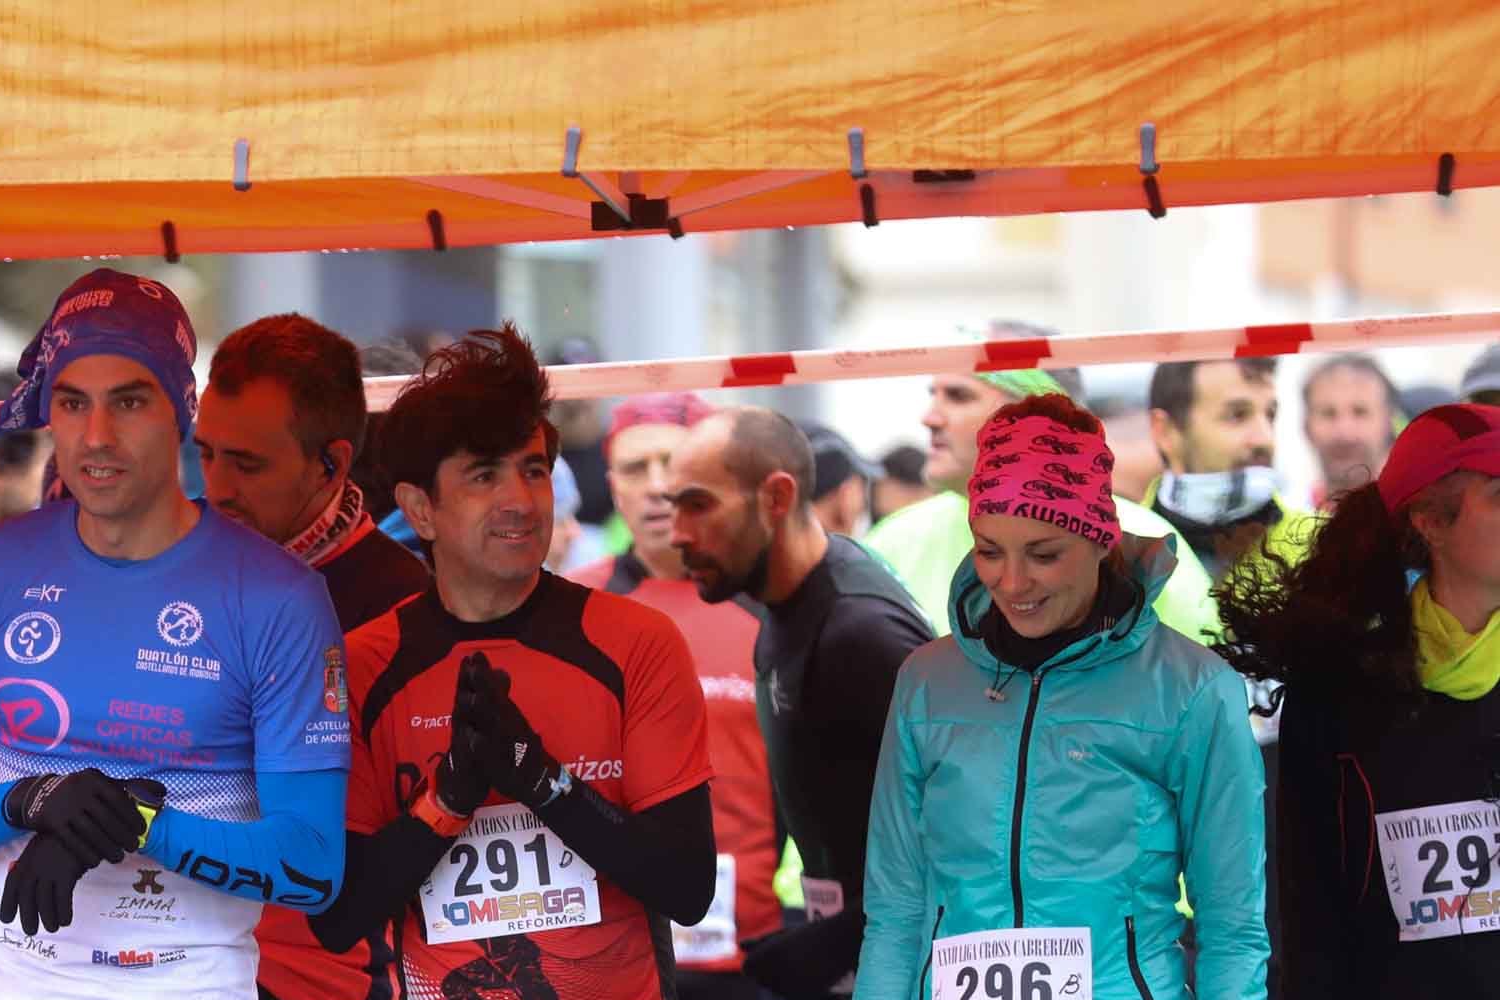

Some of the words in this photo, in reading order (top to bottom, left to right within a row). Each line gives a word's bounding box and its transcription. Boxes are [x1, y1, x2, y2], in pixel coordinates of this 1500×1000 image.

[192, 657, 221, 672] CLUB
[108, 699, 185, 726] REDES
[305, 734, 319, 744] DE
[475, 815, 511, 839] CROSS
[1444, 811, 1482, 832] CROSS
[450, 833, 552, 897] 291
[115, 895, 176, 911] IMMA
[508, 913, 586, 931] REFORMAS
[92, 949, 154, 966] BigMat
[958, 942, 978, 963] LIGA
[979, 939, 1011, 959] CROSS
[1013, 937, 1085, 958] CABRERIZOS
